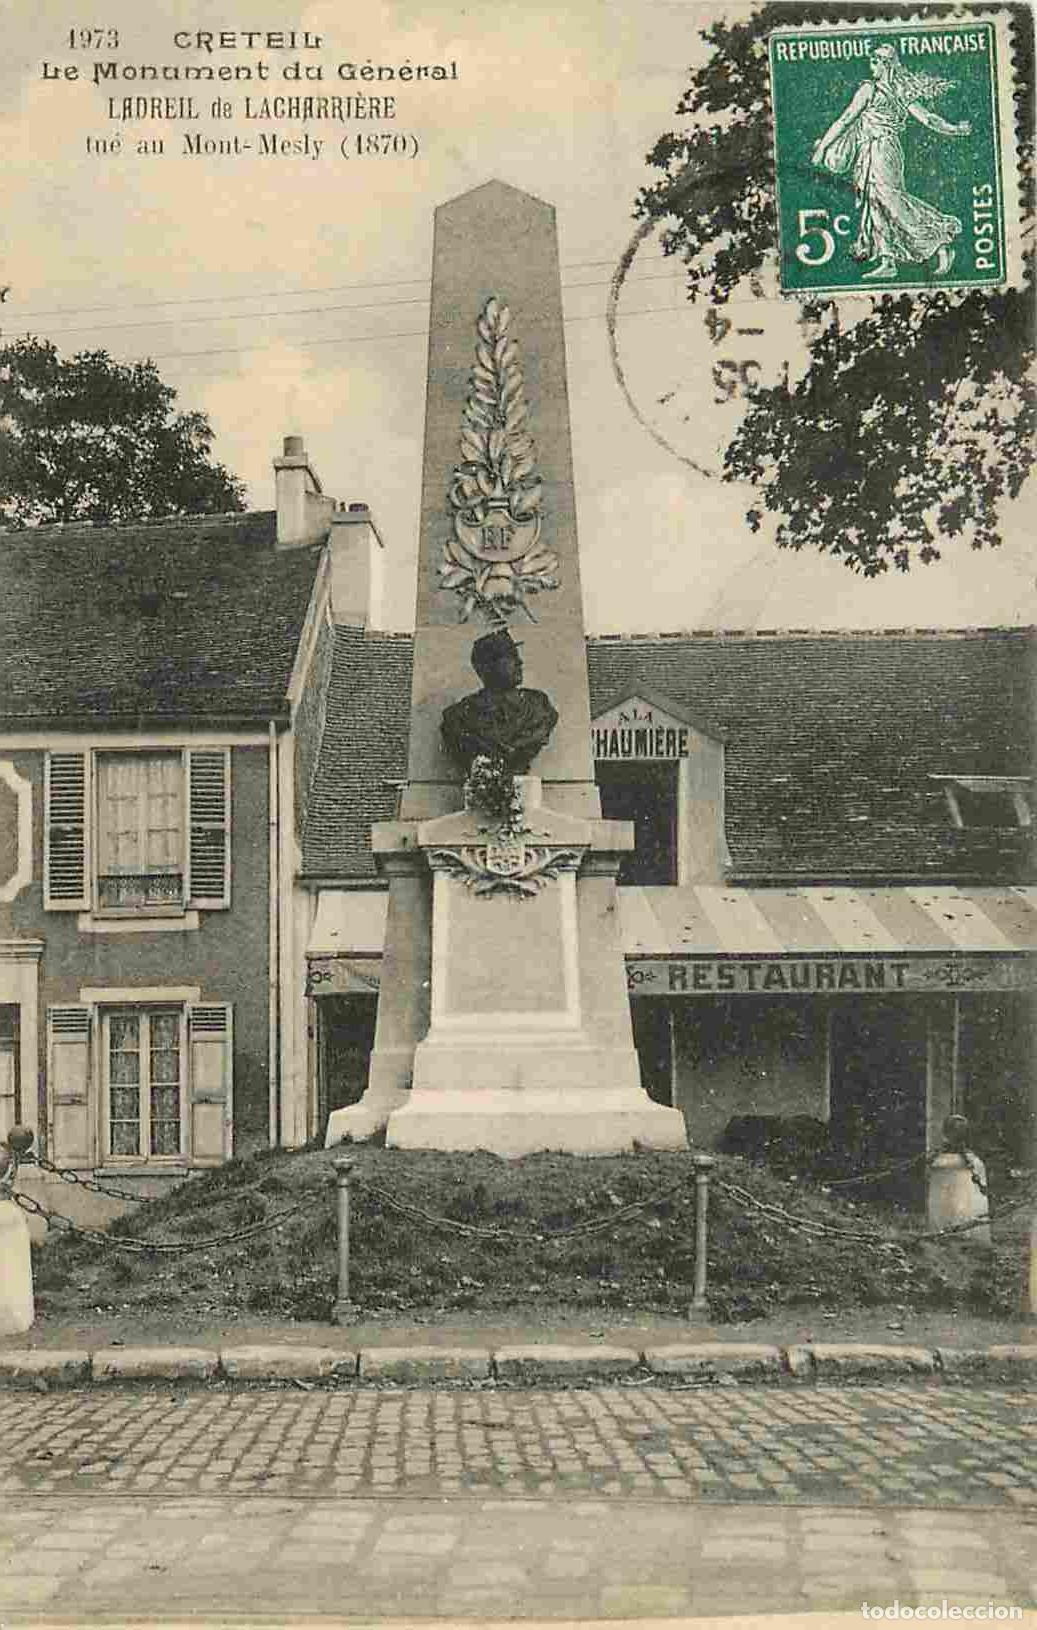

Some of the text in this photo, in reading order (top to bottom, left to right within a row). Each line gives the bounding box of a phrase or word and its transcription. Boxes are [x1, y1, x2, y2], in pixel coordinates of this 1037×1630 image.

[900, 31, 987, 56] FRANÇAISE
[972, 183, 996, 270] POSTES
[668, 962, 910, 991] RESTAURANT
